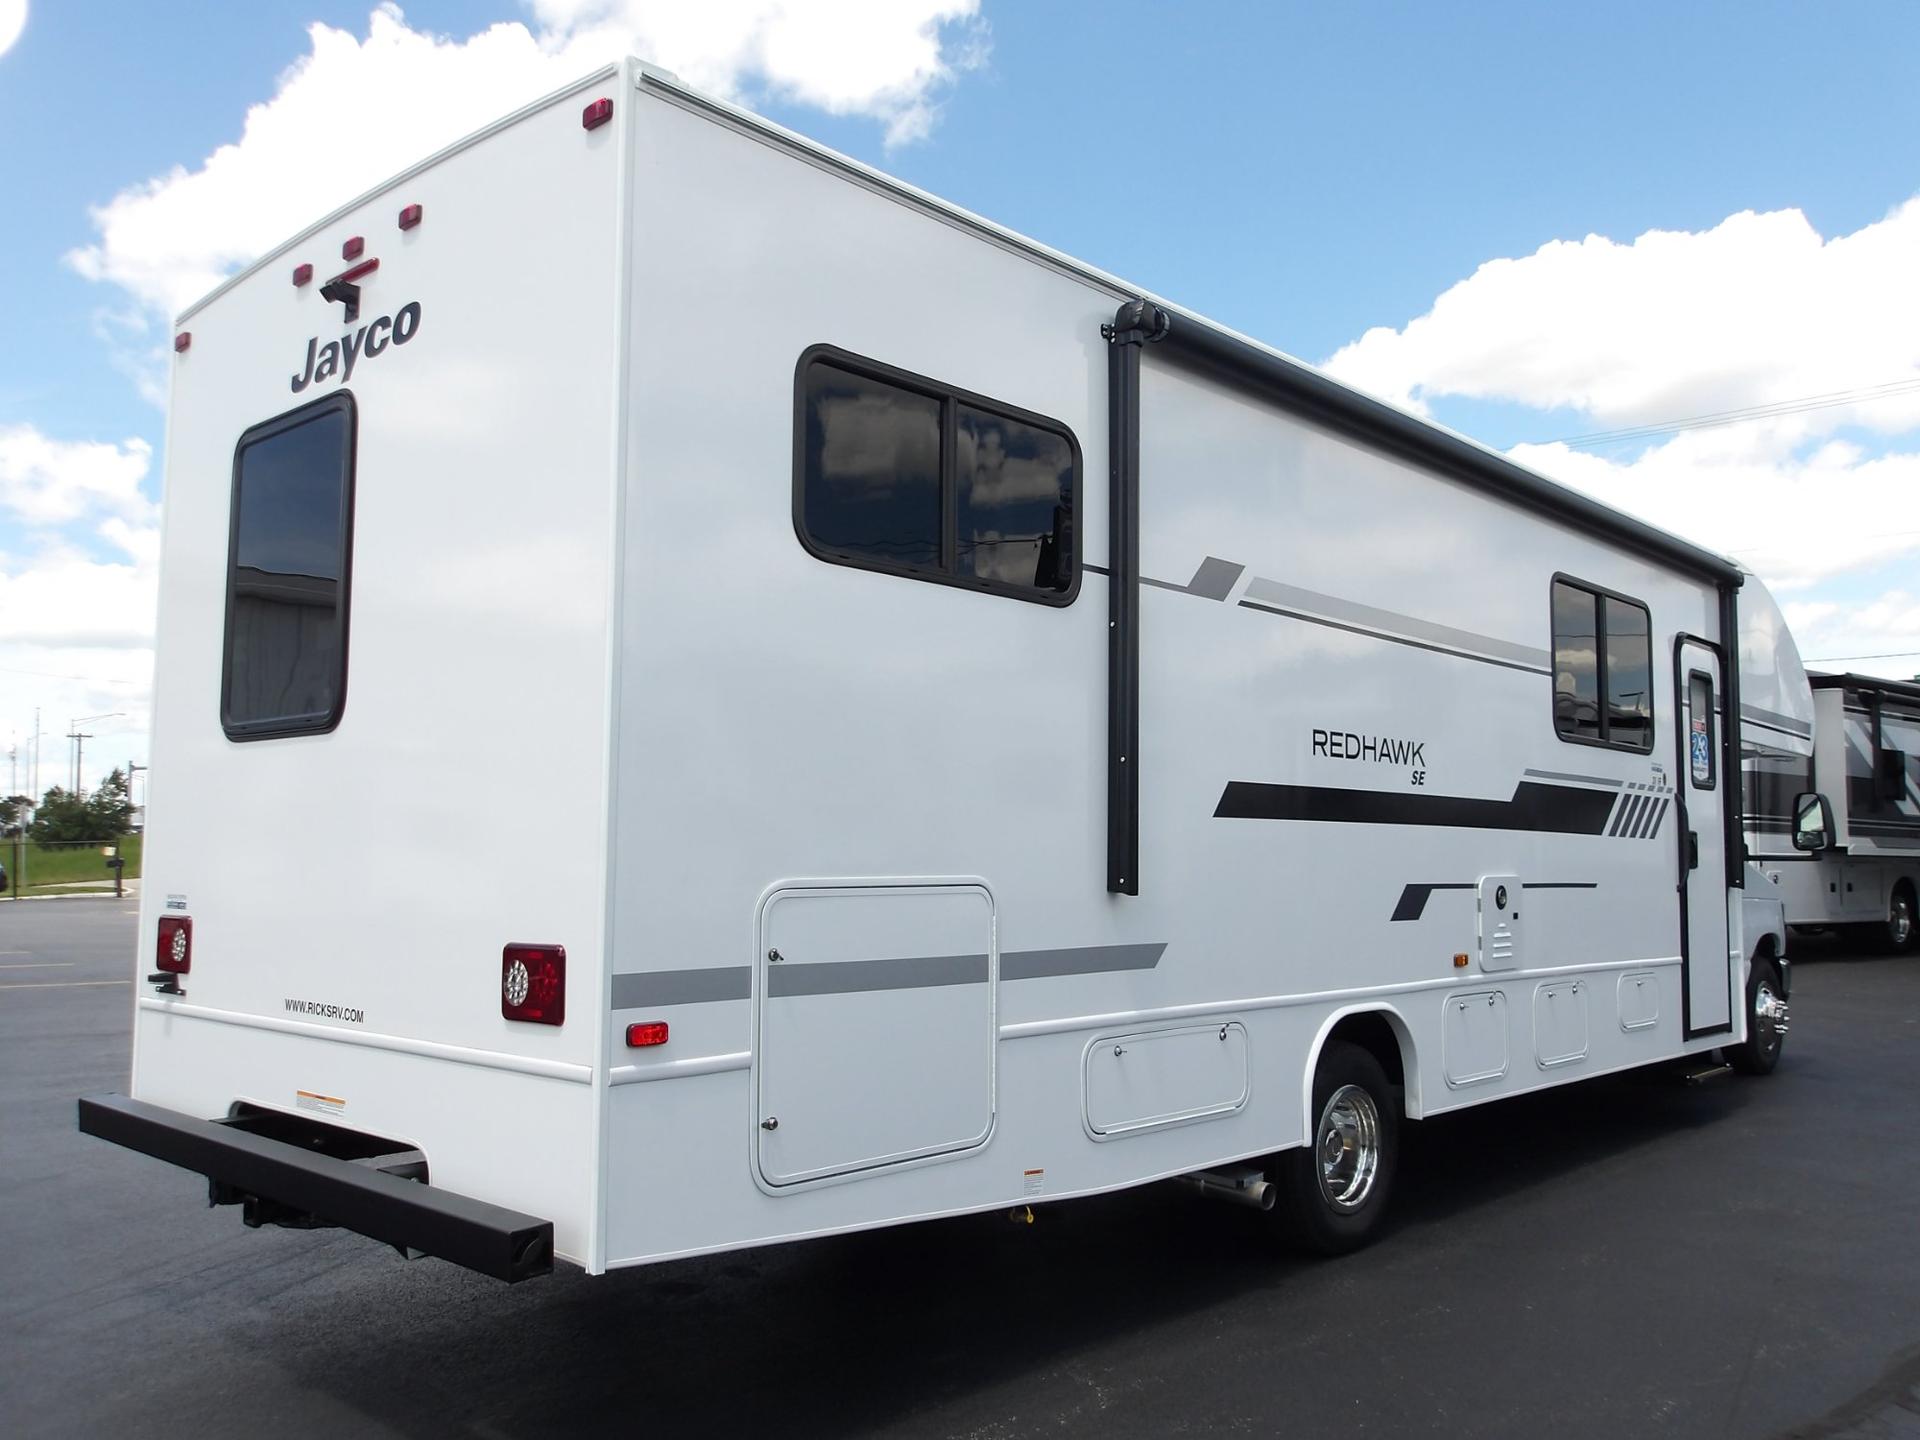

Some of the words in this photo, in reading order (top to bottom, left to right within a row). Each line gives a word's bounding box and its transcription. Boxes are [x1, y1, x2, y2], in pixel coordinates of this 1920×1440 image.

[291, 301, 421, 393] Jayco
[1312, 728, 1426, 768] REDHAWK
[1411, 770, 1426, 785] SE
[284, 998, 364, 1023] WWW.RICKSRV.COM
